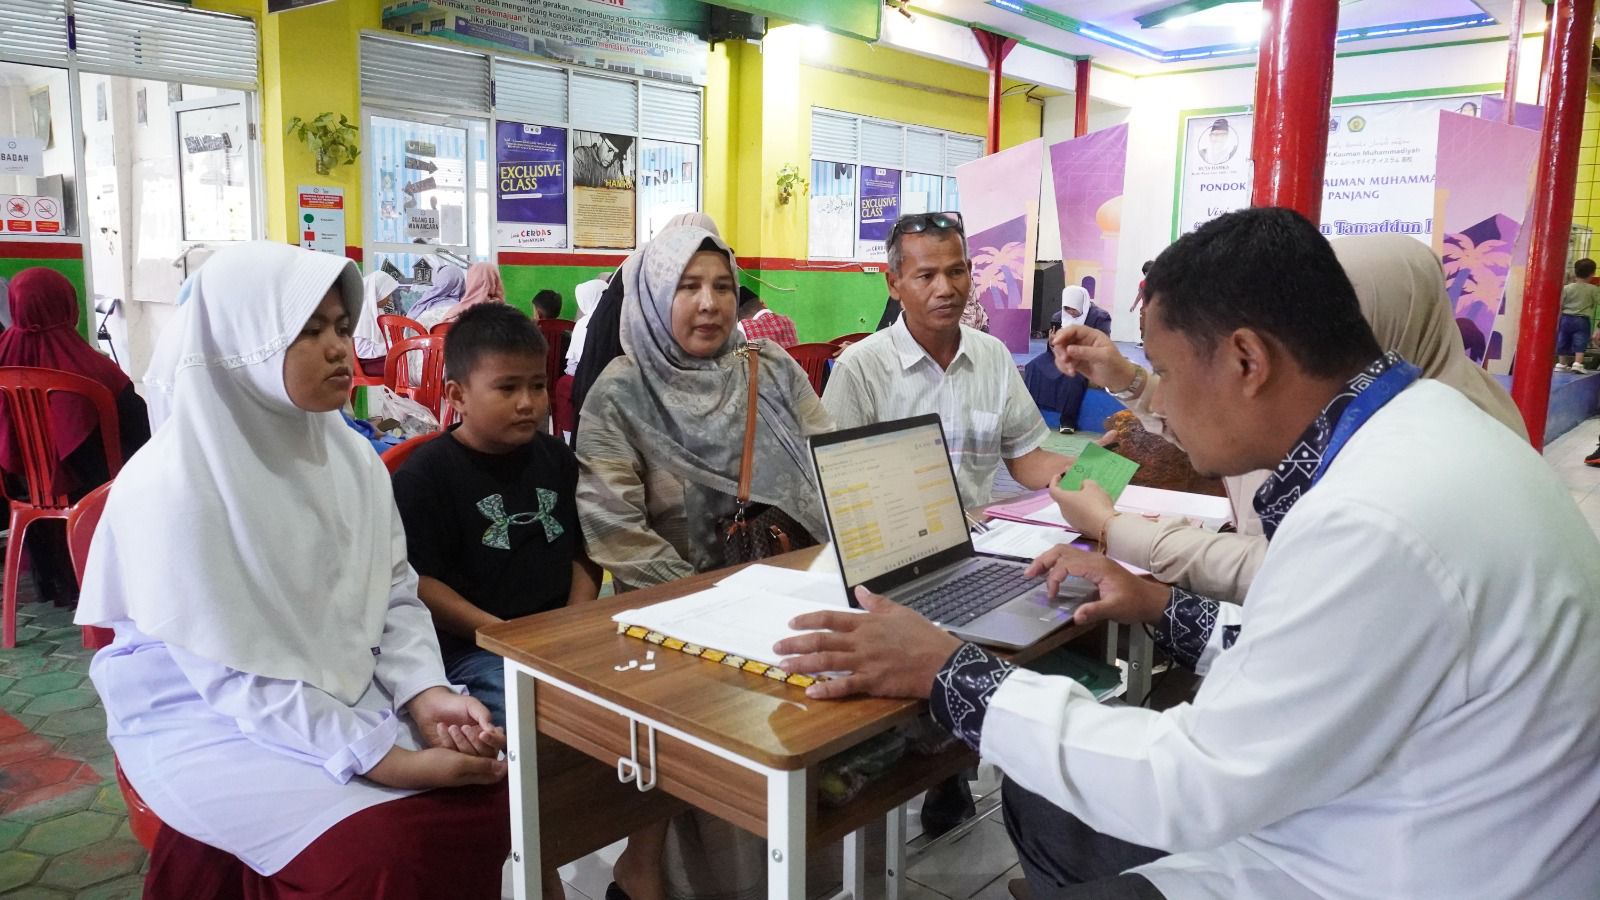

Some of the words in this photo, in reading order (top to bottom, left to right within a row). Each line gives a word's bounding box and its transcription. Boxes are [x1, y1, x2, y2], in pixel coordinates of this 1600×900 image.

[501, 2, 548, 18] mengandung
[573, 7, 615, 22] mengandung
[486, 18, 509, 29] dibuat
[510, 24, 528, 32] garis
[575, 37, 598, 46] namun
[500, 164, 562, 179] EXCLUSIVE
[500, 177, 538, 192] CLASS
[1200, 182, 1247, 192] PONDOK
[862, 196, 897, 209] EXCLUSIVE
[1328, 190, 1380, 200] PANJANG
[862, 207, 883, 218] CLASS
[520, 229, 552, 238] CERDAS
[1334, 219, 1423, 235] Tamaddun
